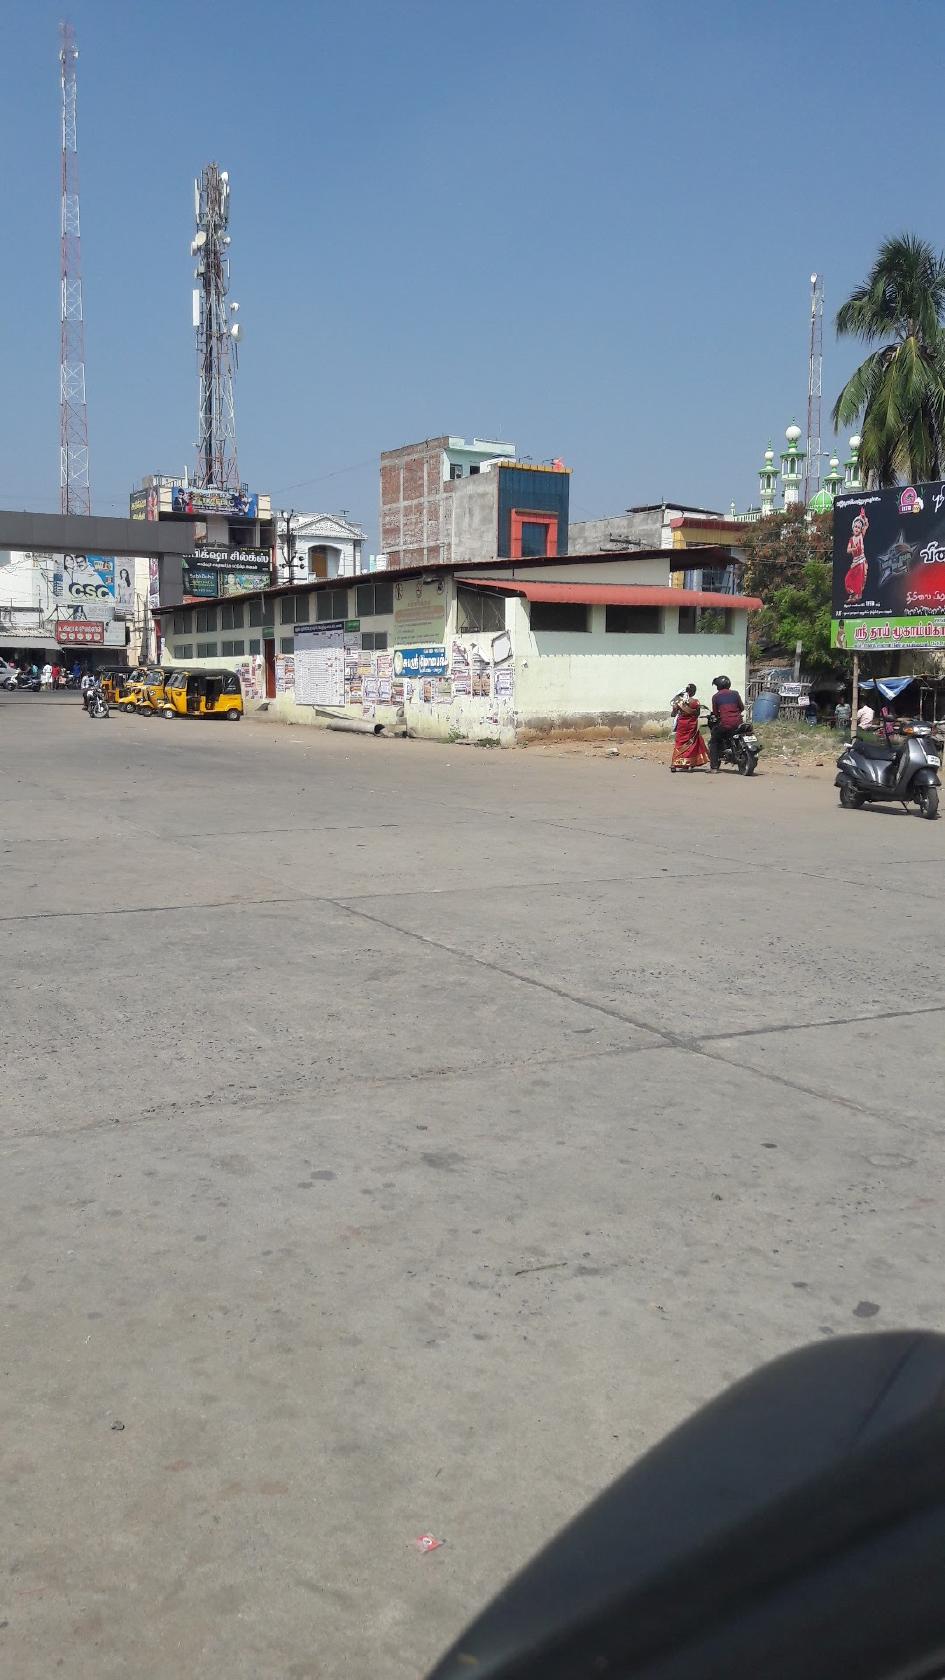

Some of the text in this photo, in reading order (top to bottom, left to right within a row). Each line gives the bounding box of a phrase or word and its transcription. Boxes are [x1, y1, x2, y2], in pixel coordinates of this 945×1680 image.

[229, 550, 269, 564] சில்க்ஸ்
[69, 582, 110, 599] CSC
[854, 622, 868, 641] ஸ்ரீ
[869, 621, 891, 640] தாய்
